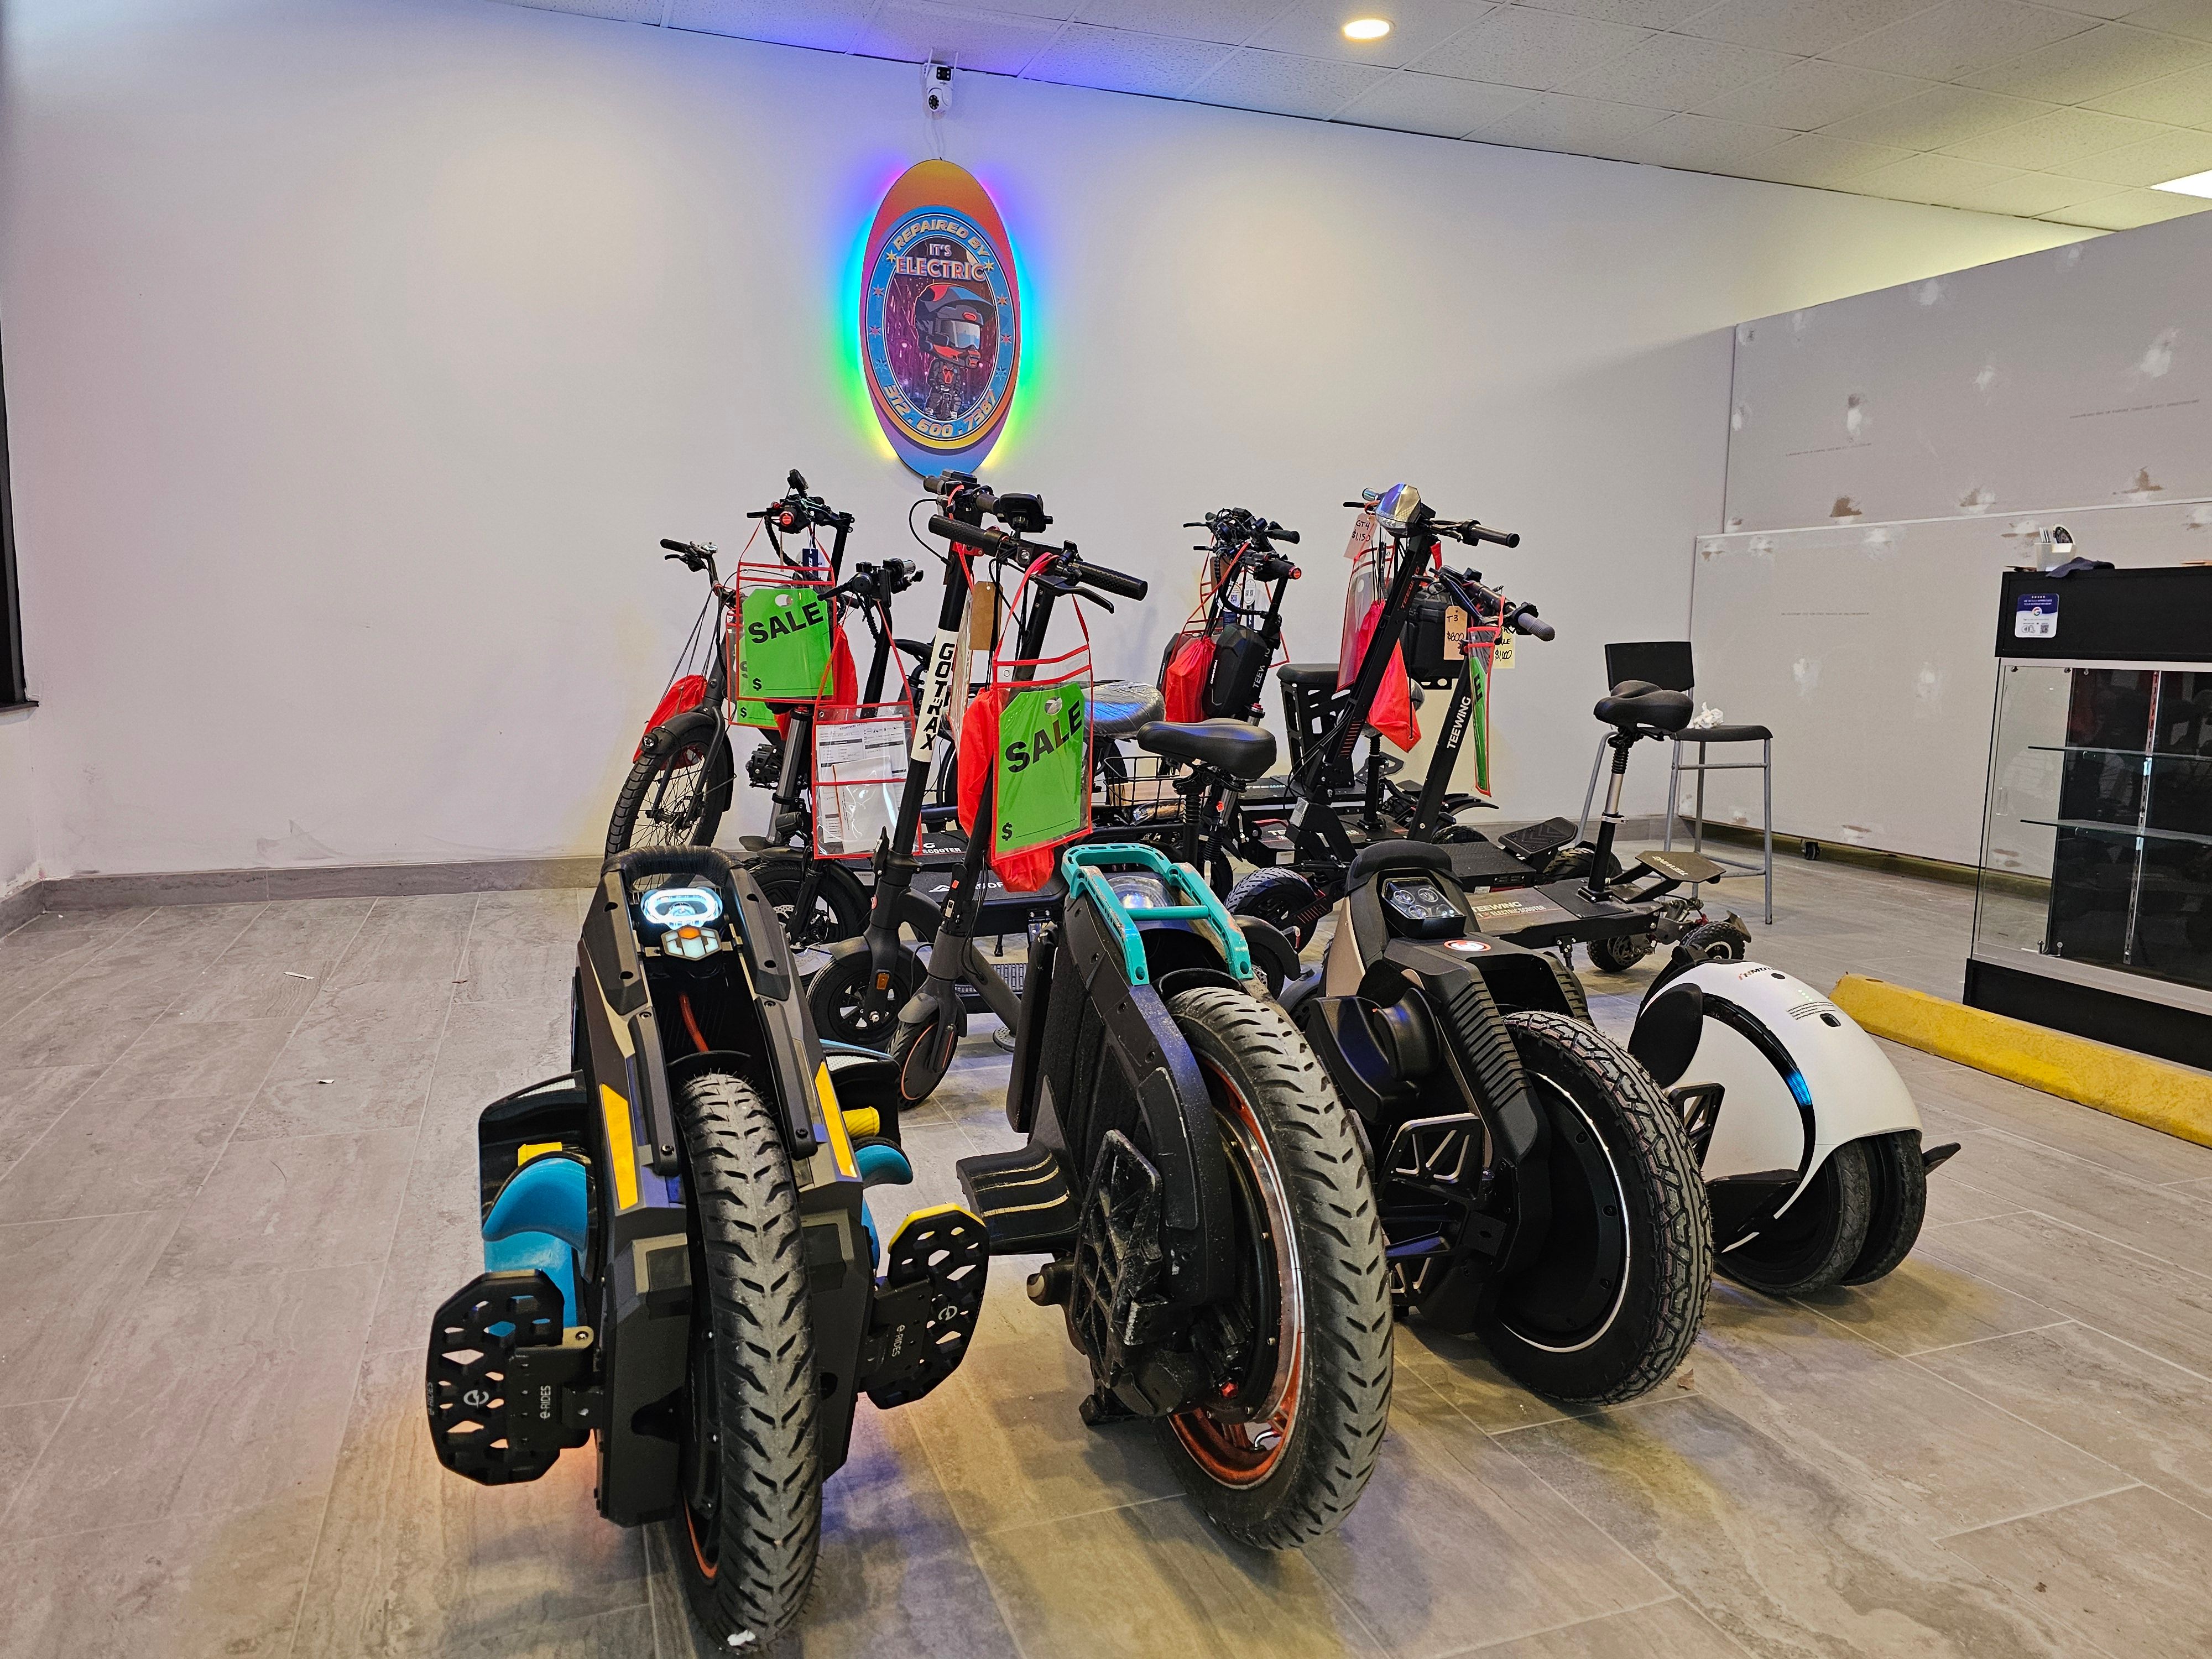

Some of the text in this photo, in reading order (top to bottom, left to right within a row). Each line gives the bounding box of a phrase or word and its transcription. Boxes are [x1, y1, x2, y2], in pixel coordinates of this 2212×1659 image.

[893, 220, 990, 256] REPAIRED BY
[929, 243, 952, 257] IT'S
[896, 256, 985, 281] ELECTRIC
[916, 419, 954, 436] 600
[748, 601, 824, 644] SALE
[1005, 700, 1082, 773] SALE
[1447, 696, 1471, 749] TEEWING
[1472, 901, 1522, 912] TEEWING
